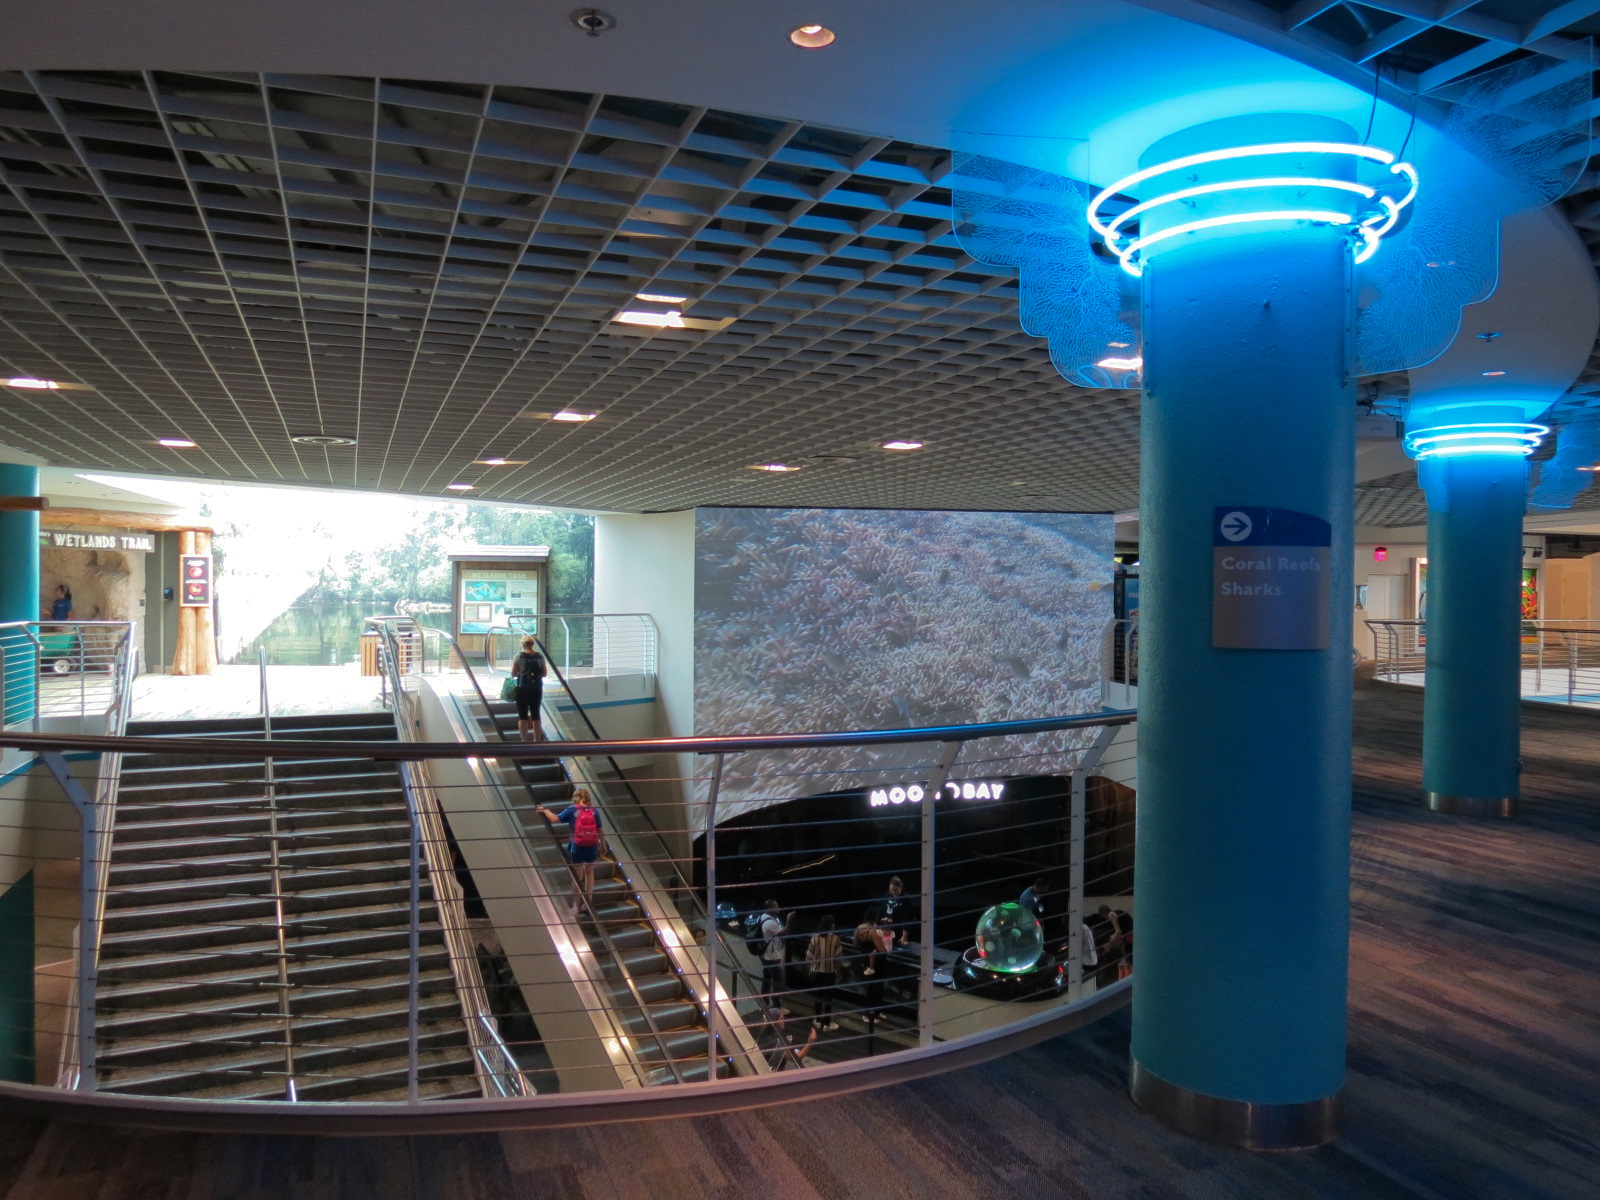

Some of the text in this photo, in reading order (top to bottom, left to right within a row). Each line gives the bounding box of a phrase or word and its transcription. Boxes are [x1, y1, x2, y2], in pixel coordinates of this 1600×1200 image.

[53, 533, 116, 548] WETLANDS
[120, 536, 152, 550] TRAIL
[1221, 557, 1321, 571] Coral Reefs
[1220, 582, 1282, 596] Sharks
[870, 782, 1005, 807] MOO BAY
